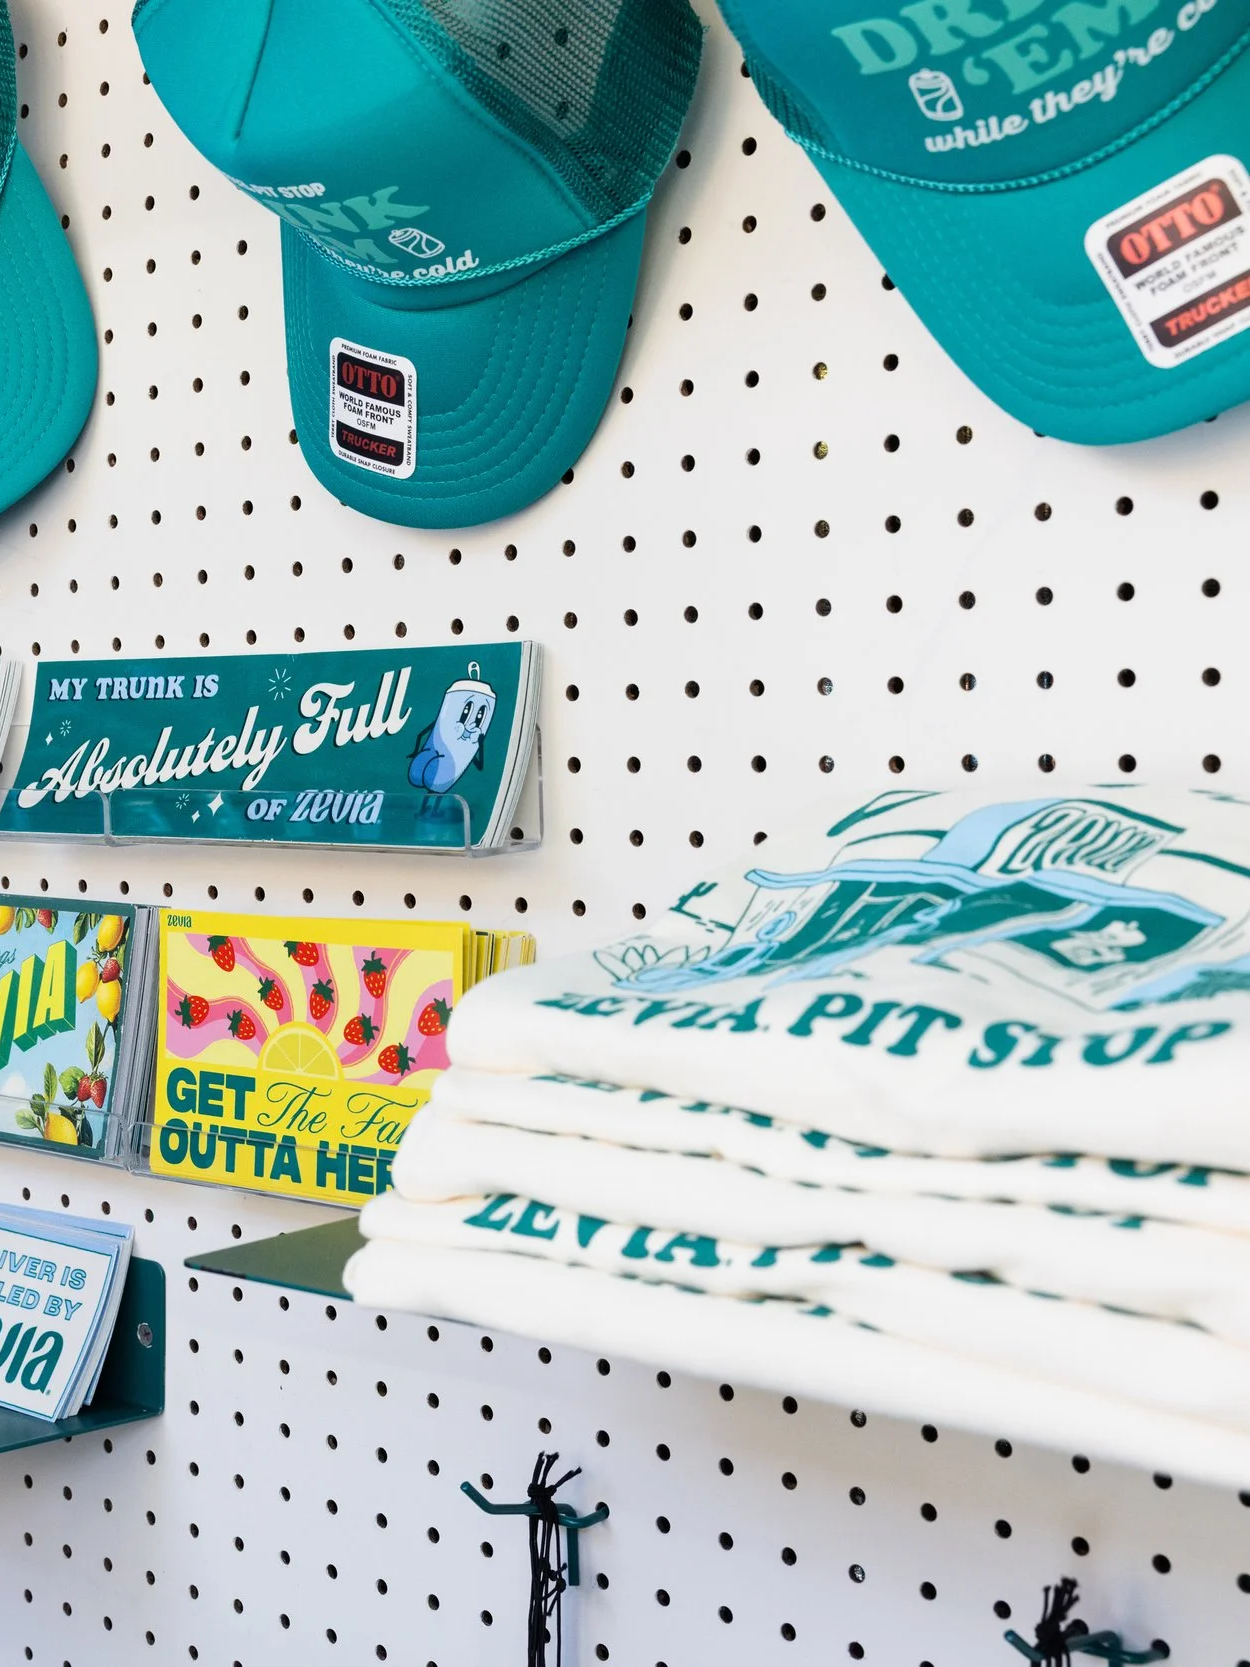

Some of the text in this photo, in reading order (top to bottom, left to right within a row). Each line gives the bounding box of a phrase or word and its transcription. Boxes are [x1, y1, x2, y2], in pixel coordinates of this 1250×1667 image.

[924, 112, 1029, 153] while
[1029, 28, 1174, 124] they're
[276, 182, 326, 199] STOP
[1120, 191, 1224, 265] OTTO
[412, 250, 480, 280] cold
[1136, 260, 1181, 291] WORLD
[1185, 225, 1244, 260] FAMOUS
[1150, 270, 1188, 295] FOAM
[1190, 242, 1238, 272] FRONT
[341, 343, 398, 366] PREMIUM FOAM FABRIC
[342, 361, 397, 398] OTTO
[338, 390, 402, 418] WORLD FAMOUS
[343, 402, 394, 426] FOAM FRONT
[356, 418, 376, 430] OSFM
[342, 430, 397, 458] TRUCKER
[338, 450, 396, 475] DURABLE SNAP CLOSURE
[48, 674, 220, 702] MY TRUNK IS
[17, 666, 412, 809] Absolutely Full
[246, 789, 386, 825] OF zevia
[167, 914, 192, 928] zevia
[787, 990, 962, 1056] PIT
[967, 1018, 1234, 1069] STOP
[166, 1067, 256, 1121] GET
[256, 1082, 332, 1134] The
[159, 1118, 302, 1184] OUTTA
[60, 1266, 88, 1290] IS
[43, 1294, 83, 1322] BY
